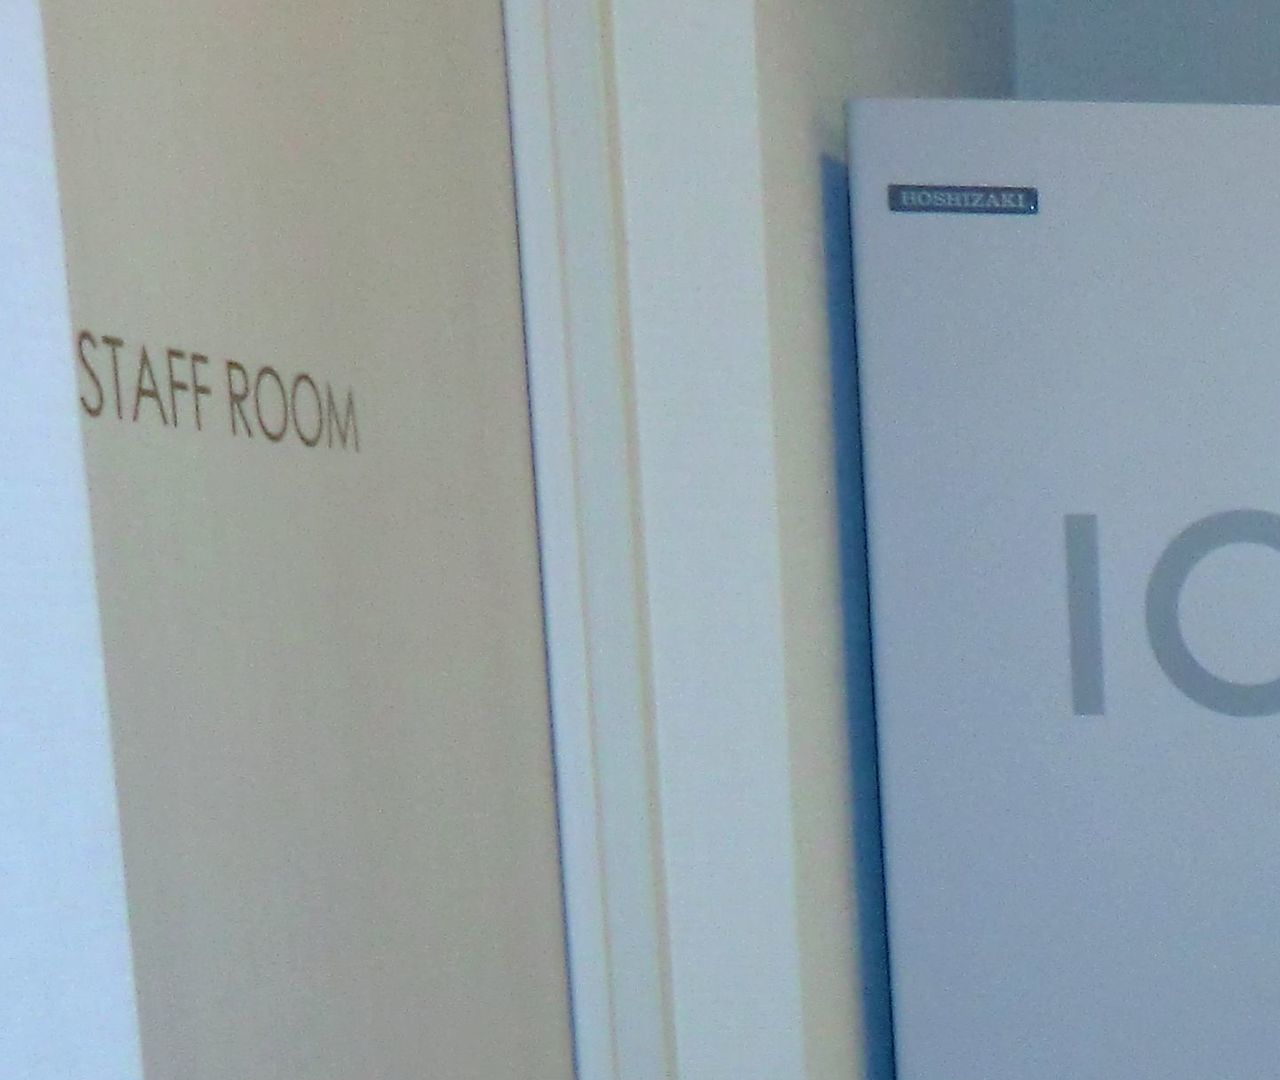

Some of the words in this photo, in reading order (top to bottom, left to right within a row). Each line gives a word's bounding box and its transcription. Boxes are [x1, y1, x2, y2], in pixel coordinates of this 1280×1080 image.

[901, 191, 1025, 207] HOSHIZAKI
[77, 330, 211, 431] STAFF
[226, 360, 360, 452] ROOM
